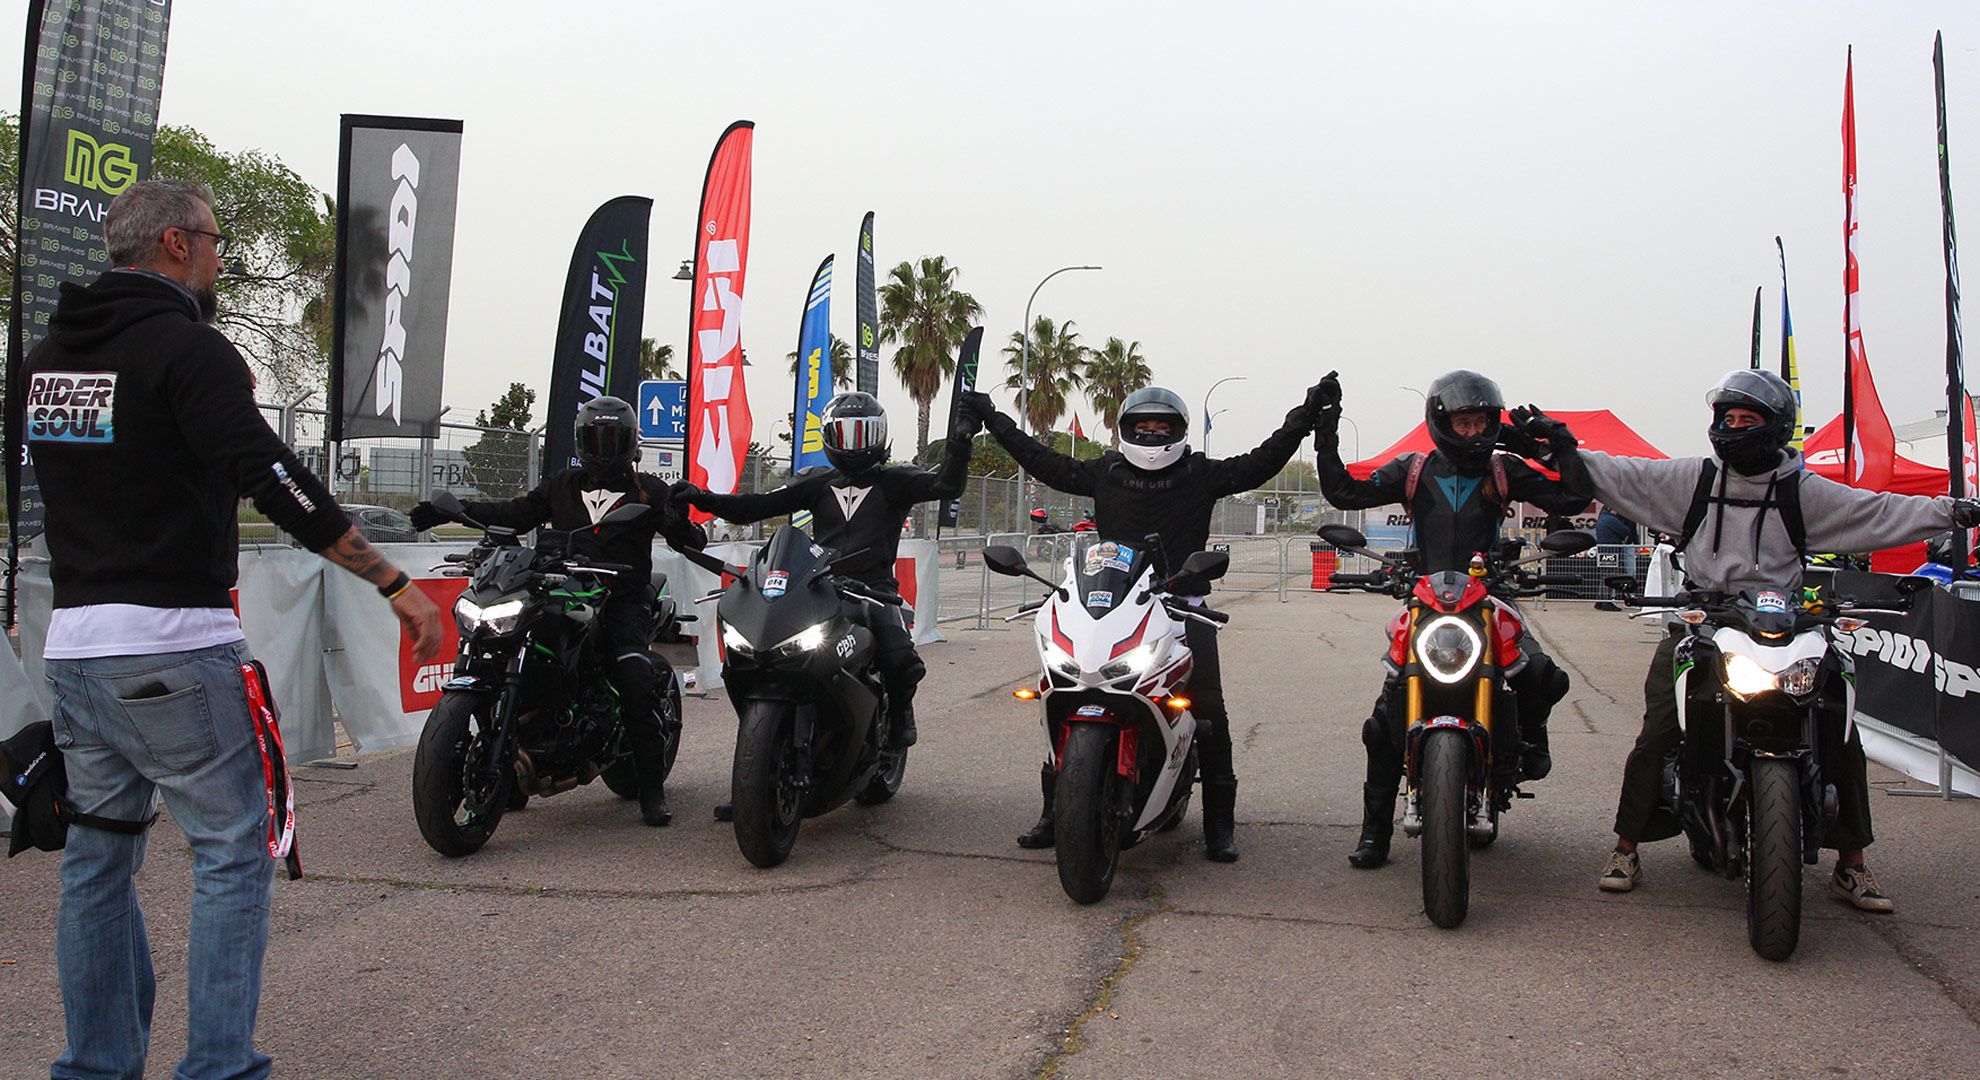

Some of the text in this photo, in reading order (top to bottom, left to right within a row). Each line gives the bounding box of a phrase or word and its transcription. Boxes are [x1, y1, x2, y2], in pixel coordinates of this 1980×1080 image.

[376, 142, 420, 427] SPIDI
[29, 378, 113, 407] RIDER
[32, 407, 105, 438] SOUL
[1830, 625, 1932, 674] SPIDI
